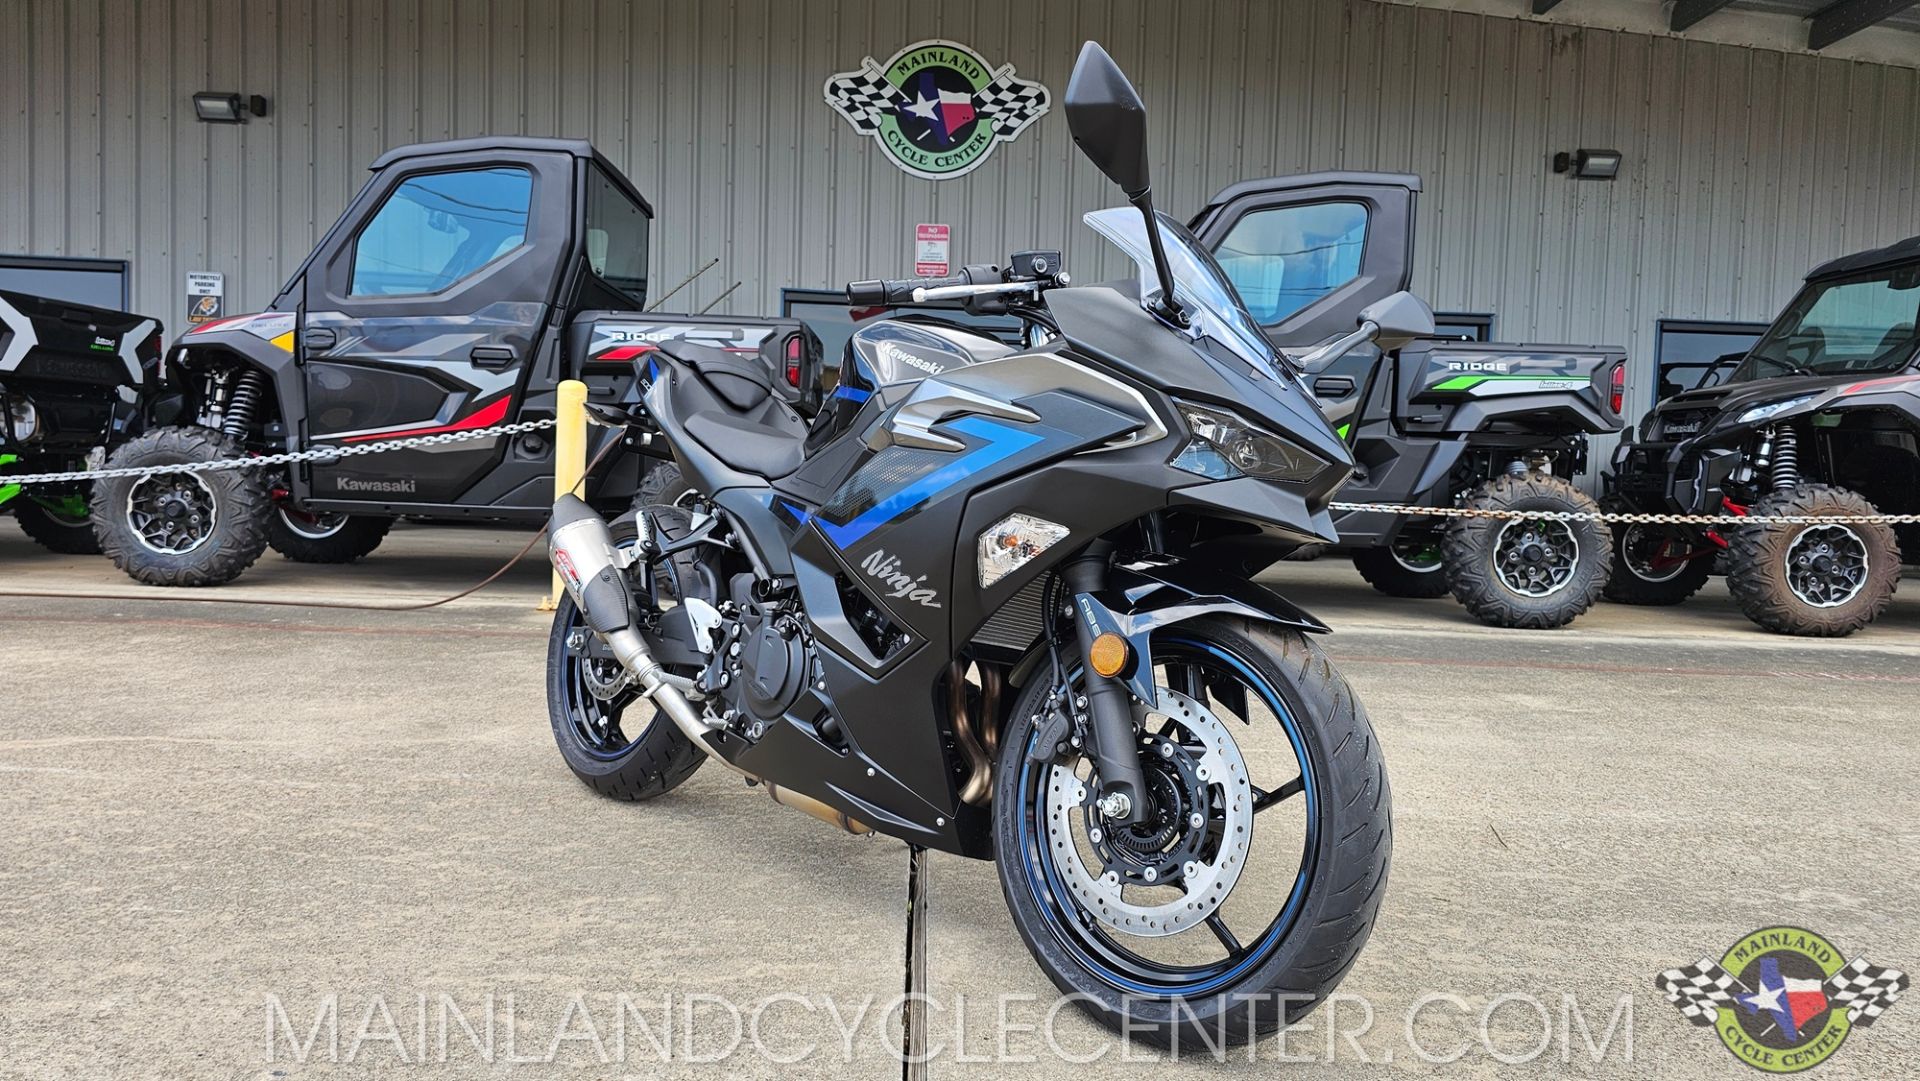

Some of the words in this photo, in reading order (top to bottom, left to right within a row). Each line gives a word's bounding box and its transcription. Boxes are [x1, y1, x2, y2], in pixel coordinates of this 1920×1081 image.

[897, 51, 980, 80] MAINLAND
[887, 129, 929, 166] CYCLE
[934, 132, 987, 168] CENTER
[611, 332, 672, 341] RIDGE
[881, 342, 945, 375] Kawasaki
[1449, 362, 1507, 371] RIDGE
[336, 477, 416, 492] Kawasaki
[861, 549, 942, 608] Ninja
